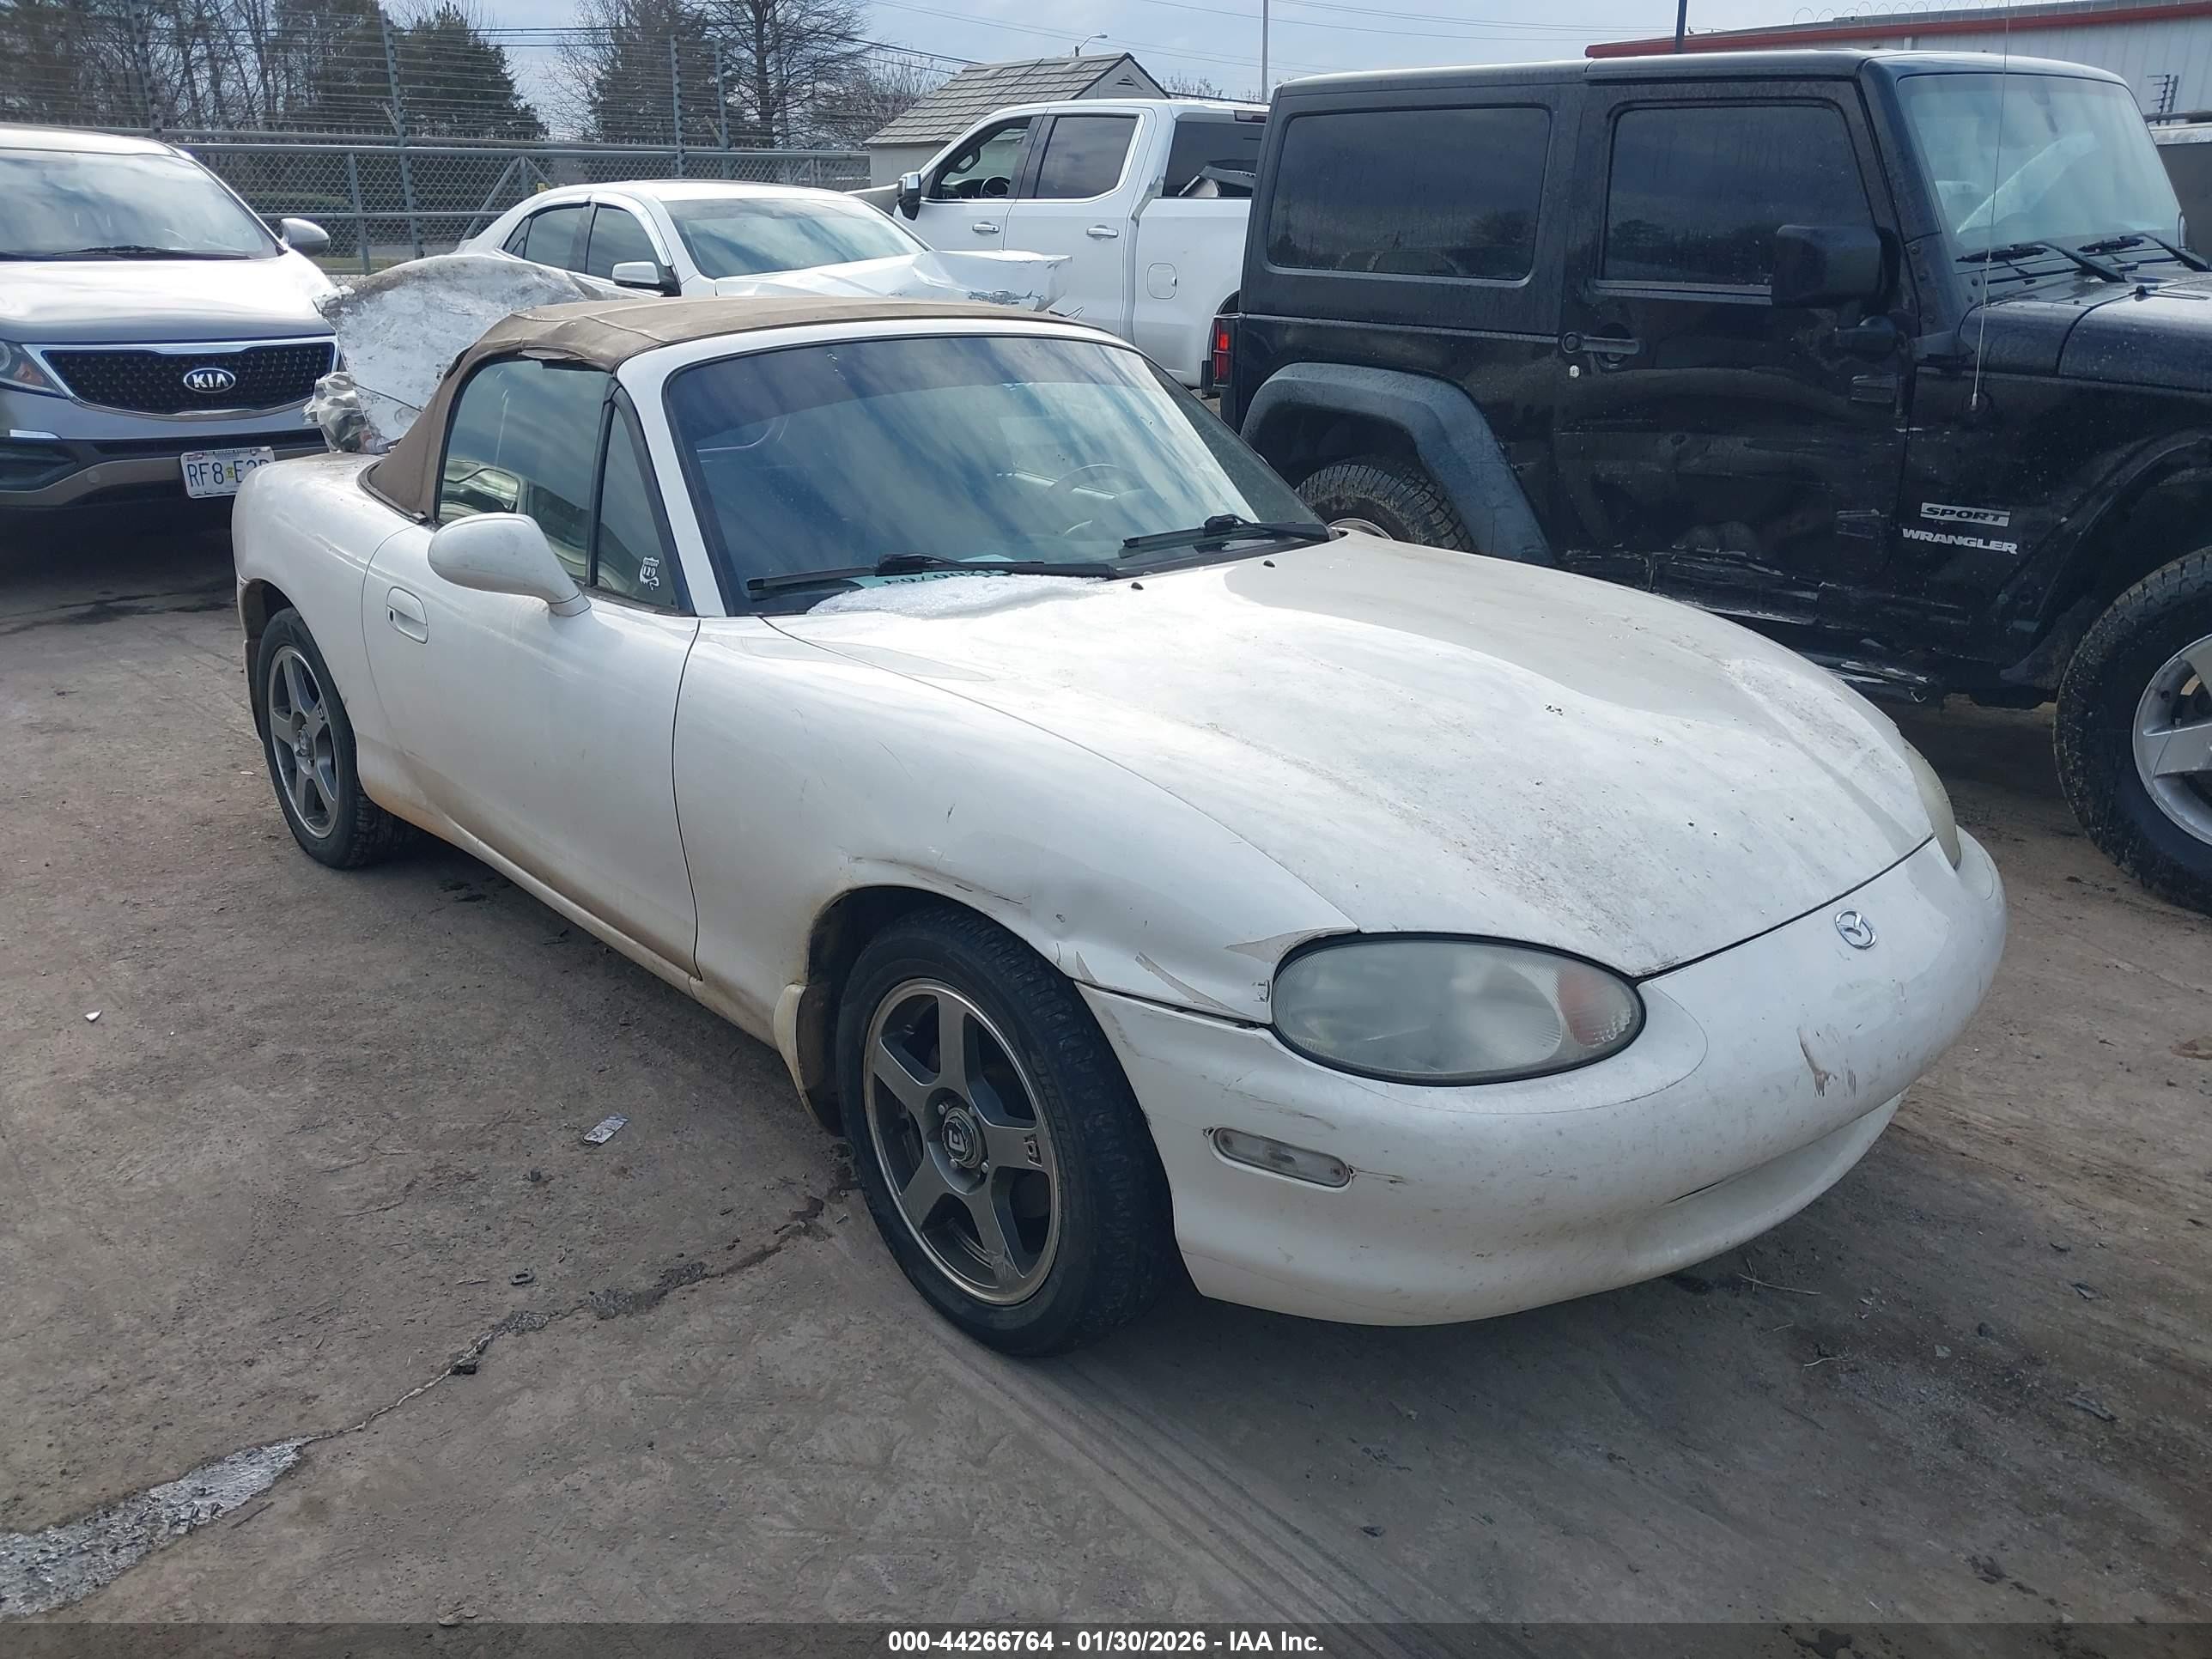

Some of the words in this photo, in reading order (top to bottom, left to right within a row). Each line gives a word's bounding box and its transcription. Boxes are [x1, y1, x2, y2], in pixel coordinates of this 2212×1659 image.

[191, 373, 229, 389] KIA
[187, 462, 224, 487] RF8
[1921, 506, 2010, 523] SPORT
[1902, 528, 2018, 555] WRANGLER
